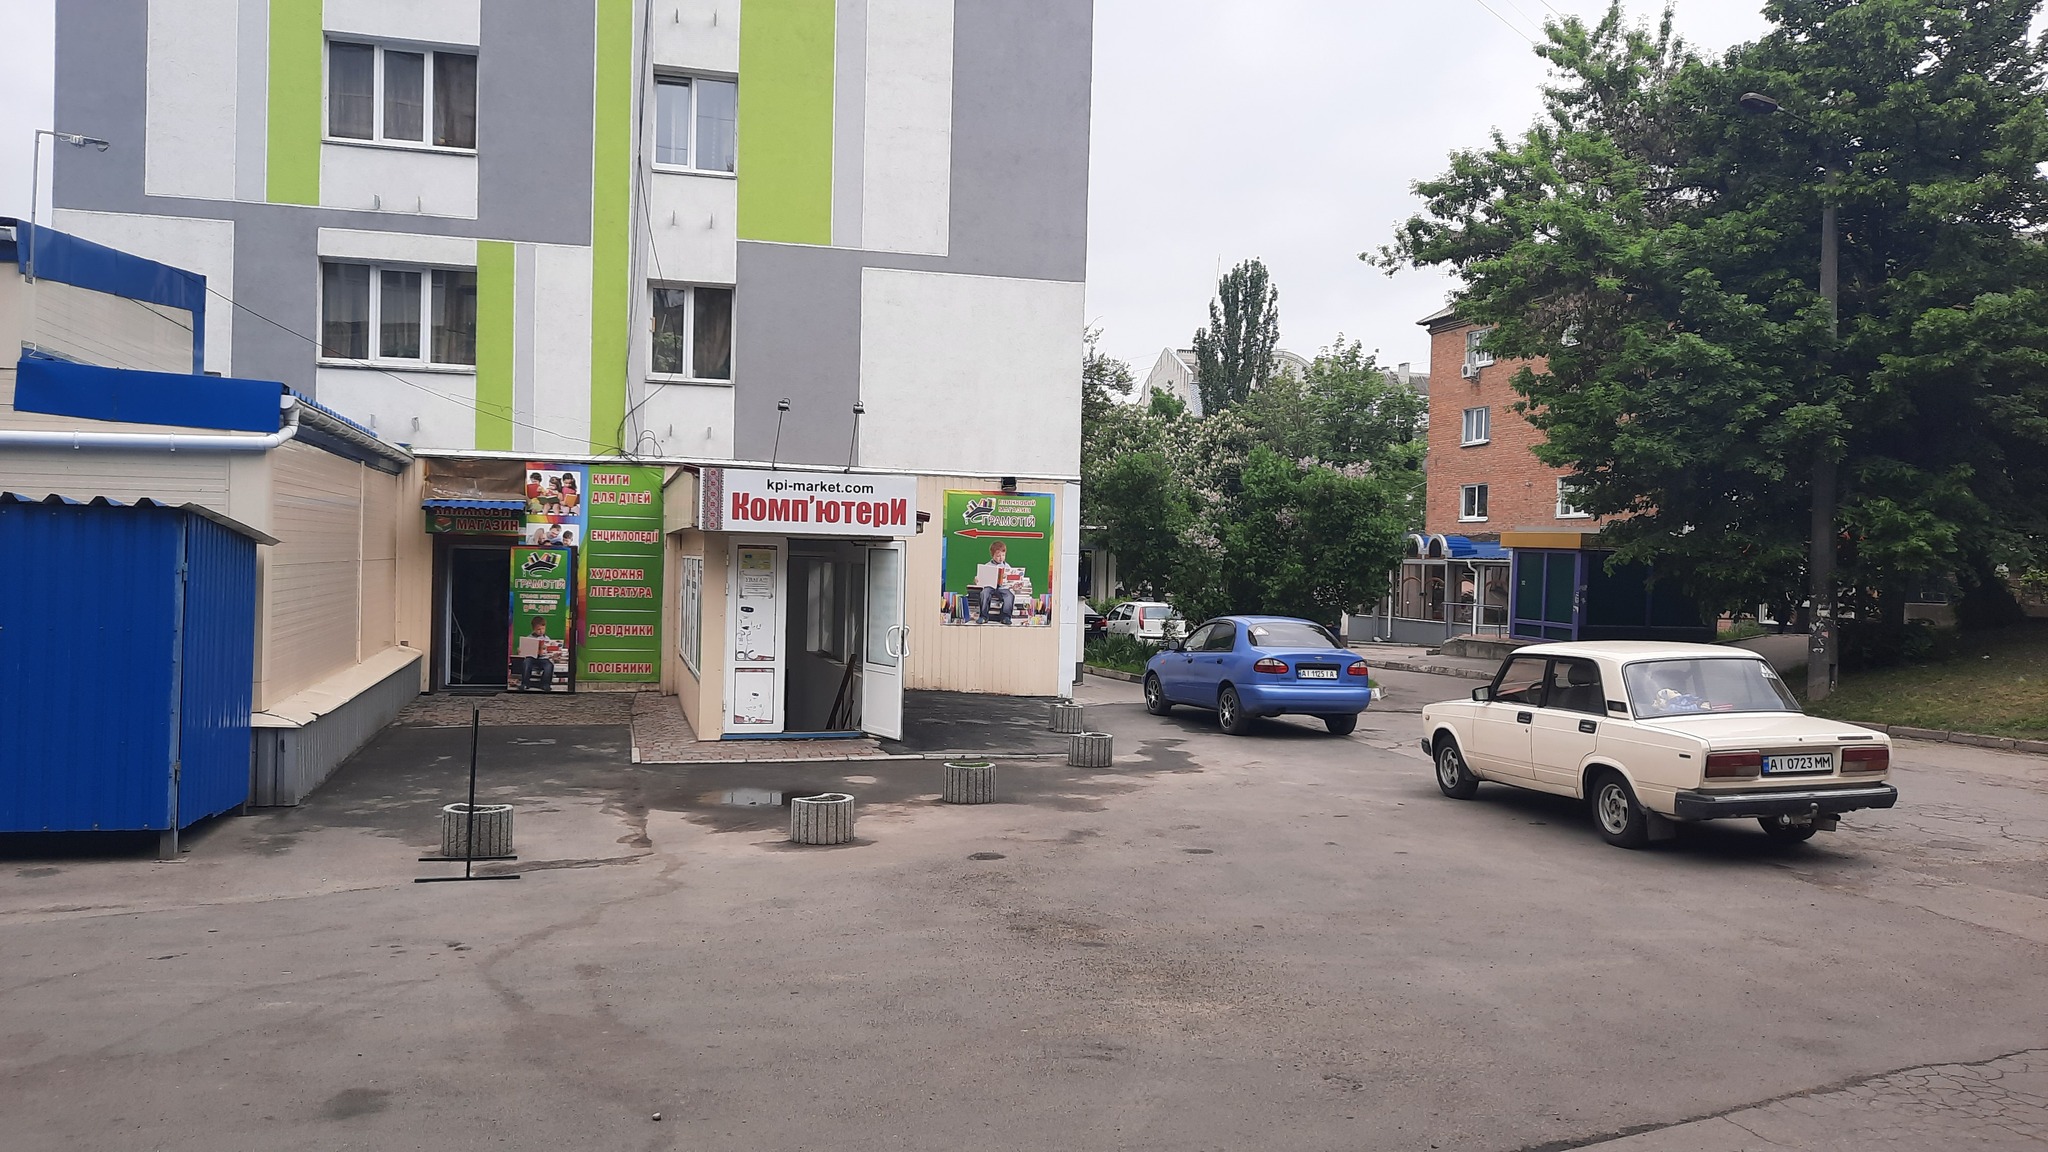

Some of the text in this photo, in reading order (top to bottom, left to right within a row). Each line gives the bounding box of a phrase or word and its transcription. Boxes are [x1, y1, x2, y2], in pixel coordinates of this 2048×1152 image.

[592, 473, 630, 485] КНИГИ
[766, 479, 874, 494] kpi-market.com
[591, 490, 652, 505] ДЛЯ ДІТЕЙ
[455, 518, 519, 531] МАГАЗИН
[981, 515, 1035, 527] ГРАМОТІЙ
[591, 529, 659, 544] ЕНЦИКЛОПЕДІЇ
[590, 568, 644, 580] ХУДОЖНЯ
[515, 578, 566, 589] ГРАМОТІЙ
[589, 586, 653, 598] ЛІТЕРАТУРА
[589, 624, 653, 637] ДОВІДНИКИ
[588, 662, 653, 674] ПОСІБНИКИ
[1770, 756, 1831, 770] AI 0723 MM
